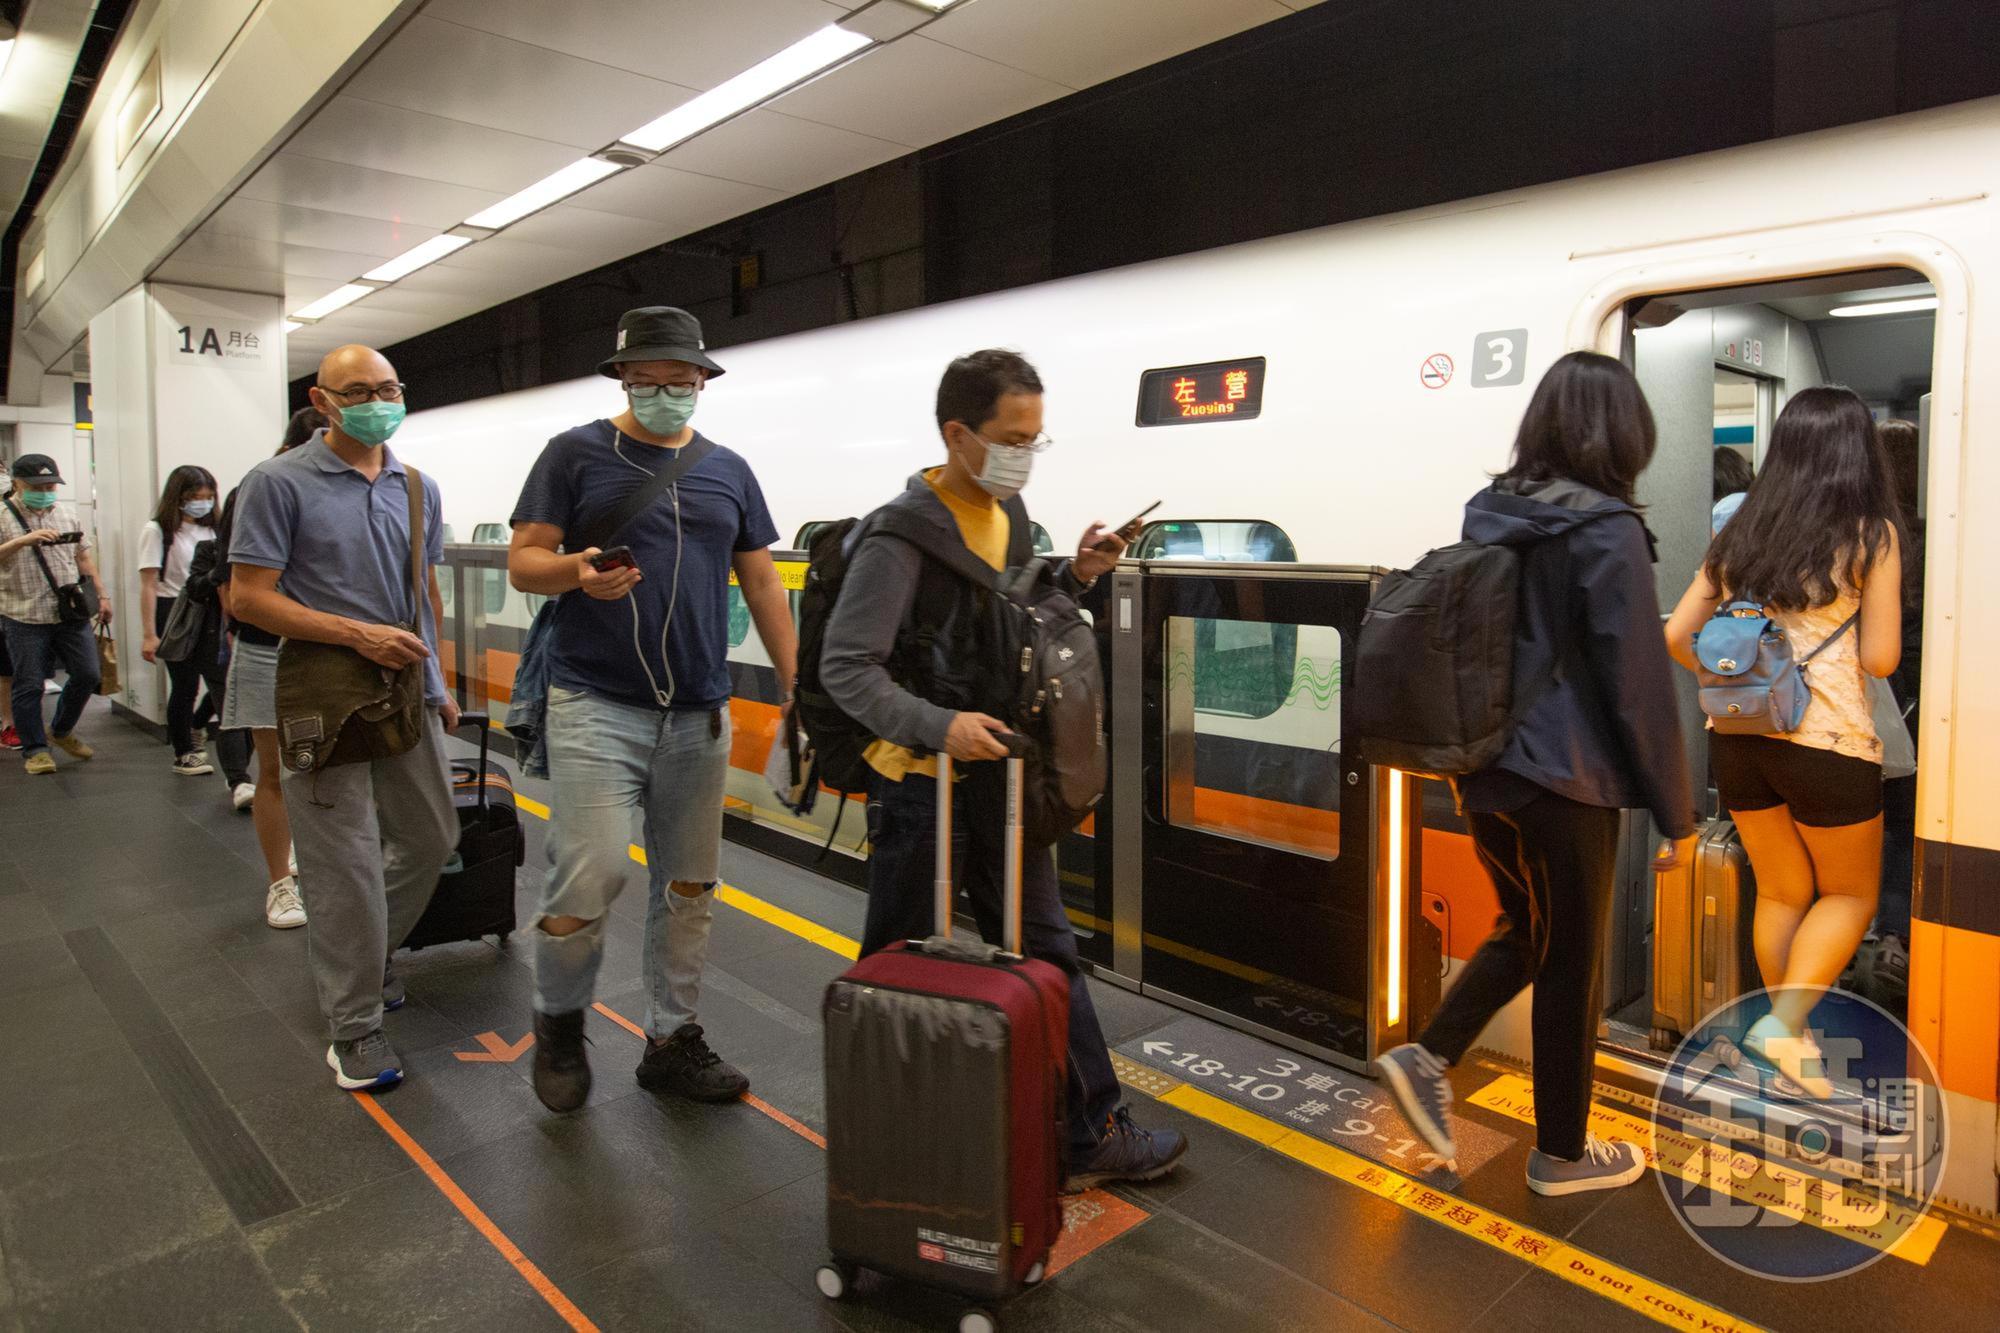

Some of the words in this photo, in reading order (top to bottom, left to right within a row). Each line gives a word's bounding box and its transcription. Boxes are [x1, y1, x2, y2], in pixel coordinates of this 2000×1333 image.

[178, 325, 223, 356] 1A
[227, 331, 260, 349] 月台
[226, 350, 261, 360] Platform
[1484, 337, 1514, 381] 3
[1182, 401, 1234, 416] Zuoying
[1170, 1052, 1286, 1101] 18-10
[1295, 1099, 1331, 1116] 排
[1334, 1088, 1392, 1114] Car
[1285, 1109, 1314, 1124] Row
[1668, 1158, 1711, 1178] Mind
[1716, 1176, 1746, 1191] the
[1752, 1191, 1840, 1225] platform
[1844, 1223, 1882, 1241] gap
[1569, 1260, 1596, 1276] Do
[1600, 1275, 1634, 1294] not
[1644, 1295, 1696, 1322] cross
